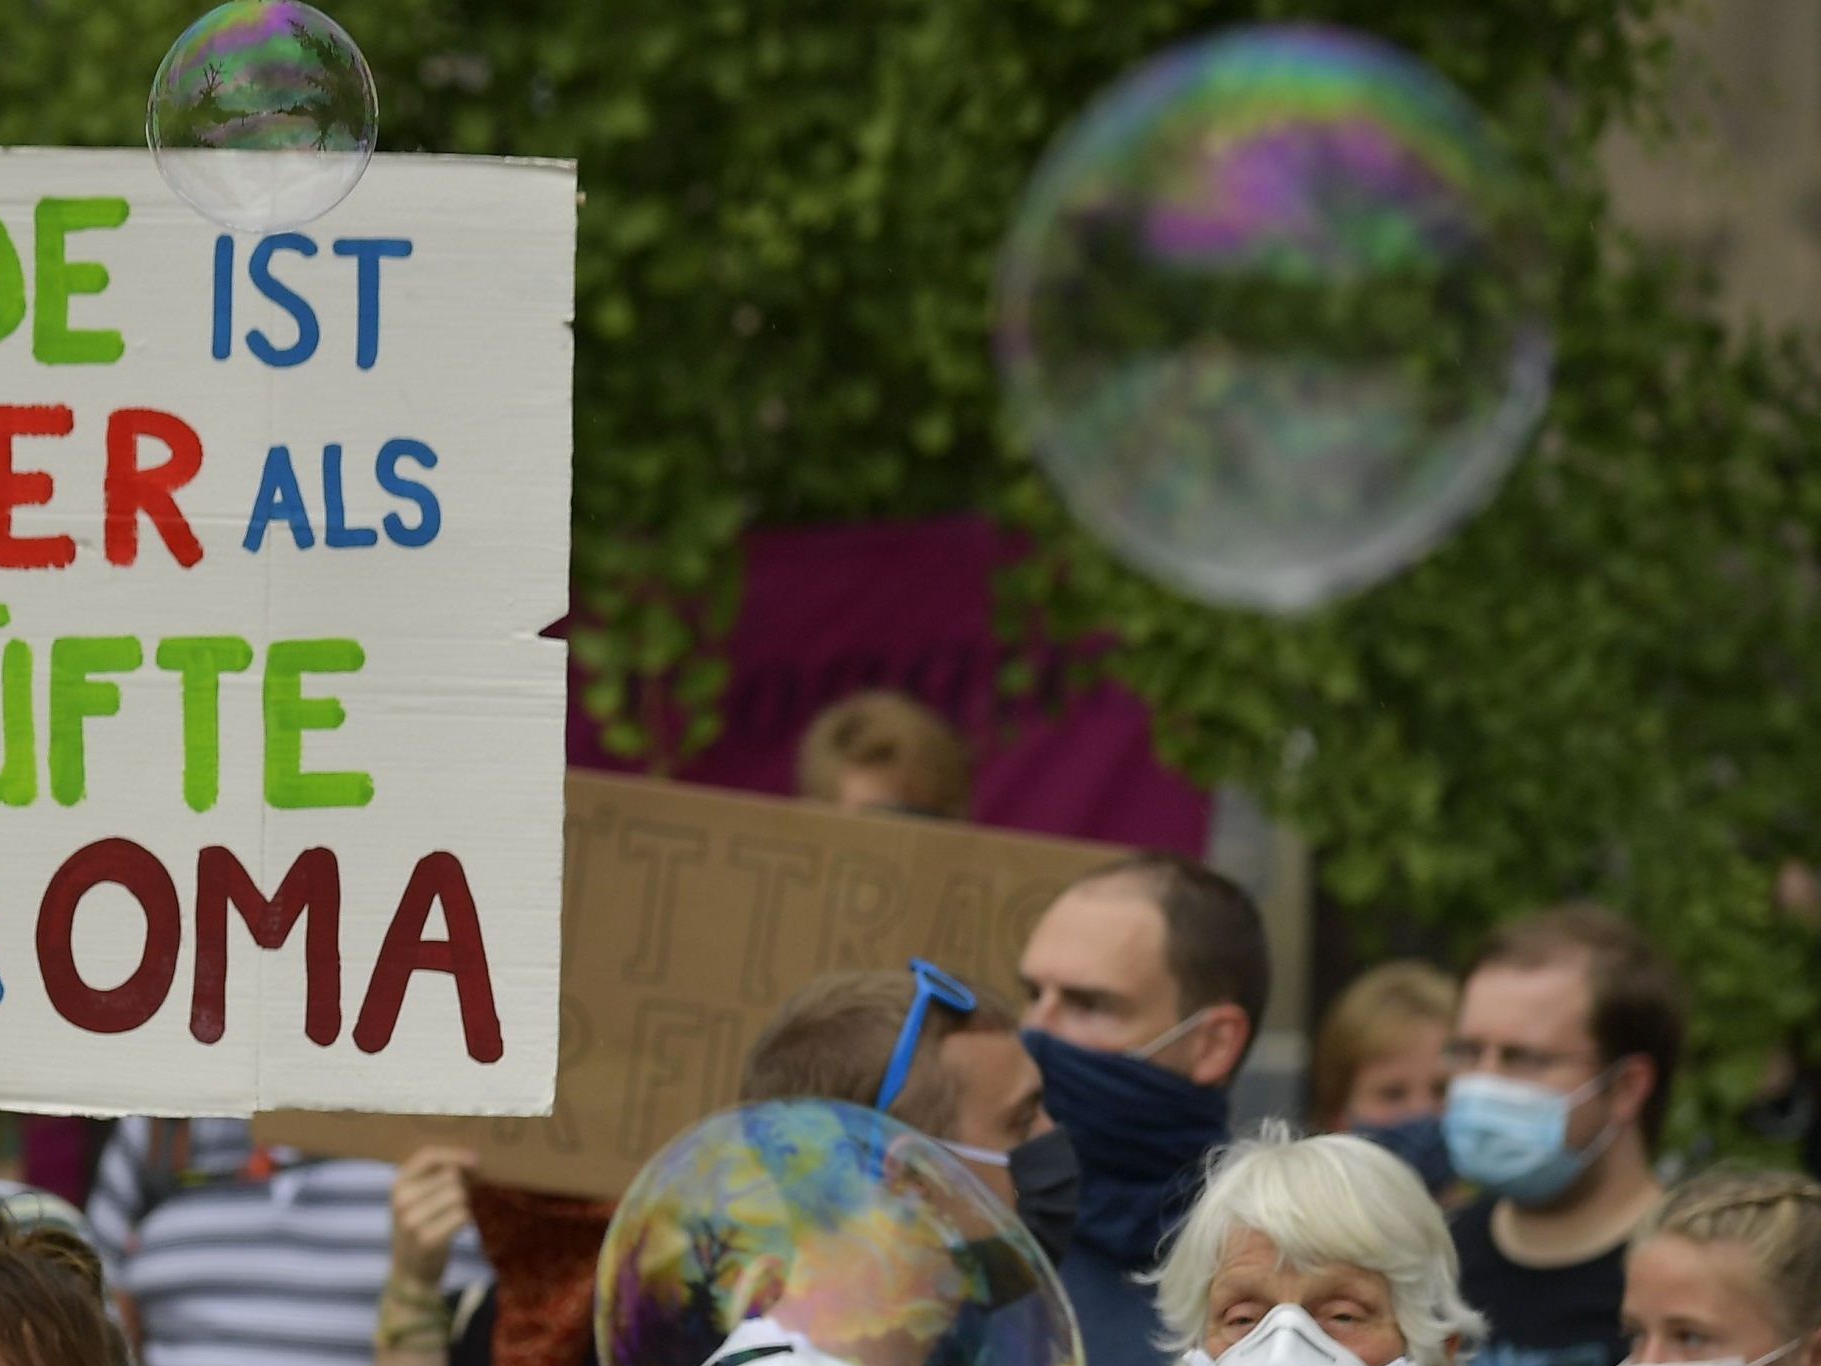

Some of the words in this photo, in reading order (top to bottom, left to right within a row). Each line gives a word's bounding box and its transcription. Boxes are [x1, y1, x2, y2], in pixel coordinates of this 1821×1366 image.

[211, 232, 413, 370] IST
[242, 438, 441, 553] ALS
[35, 836, 505, 1065] OMA
